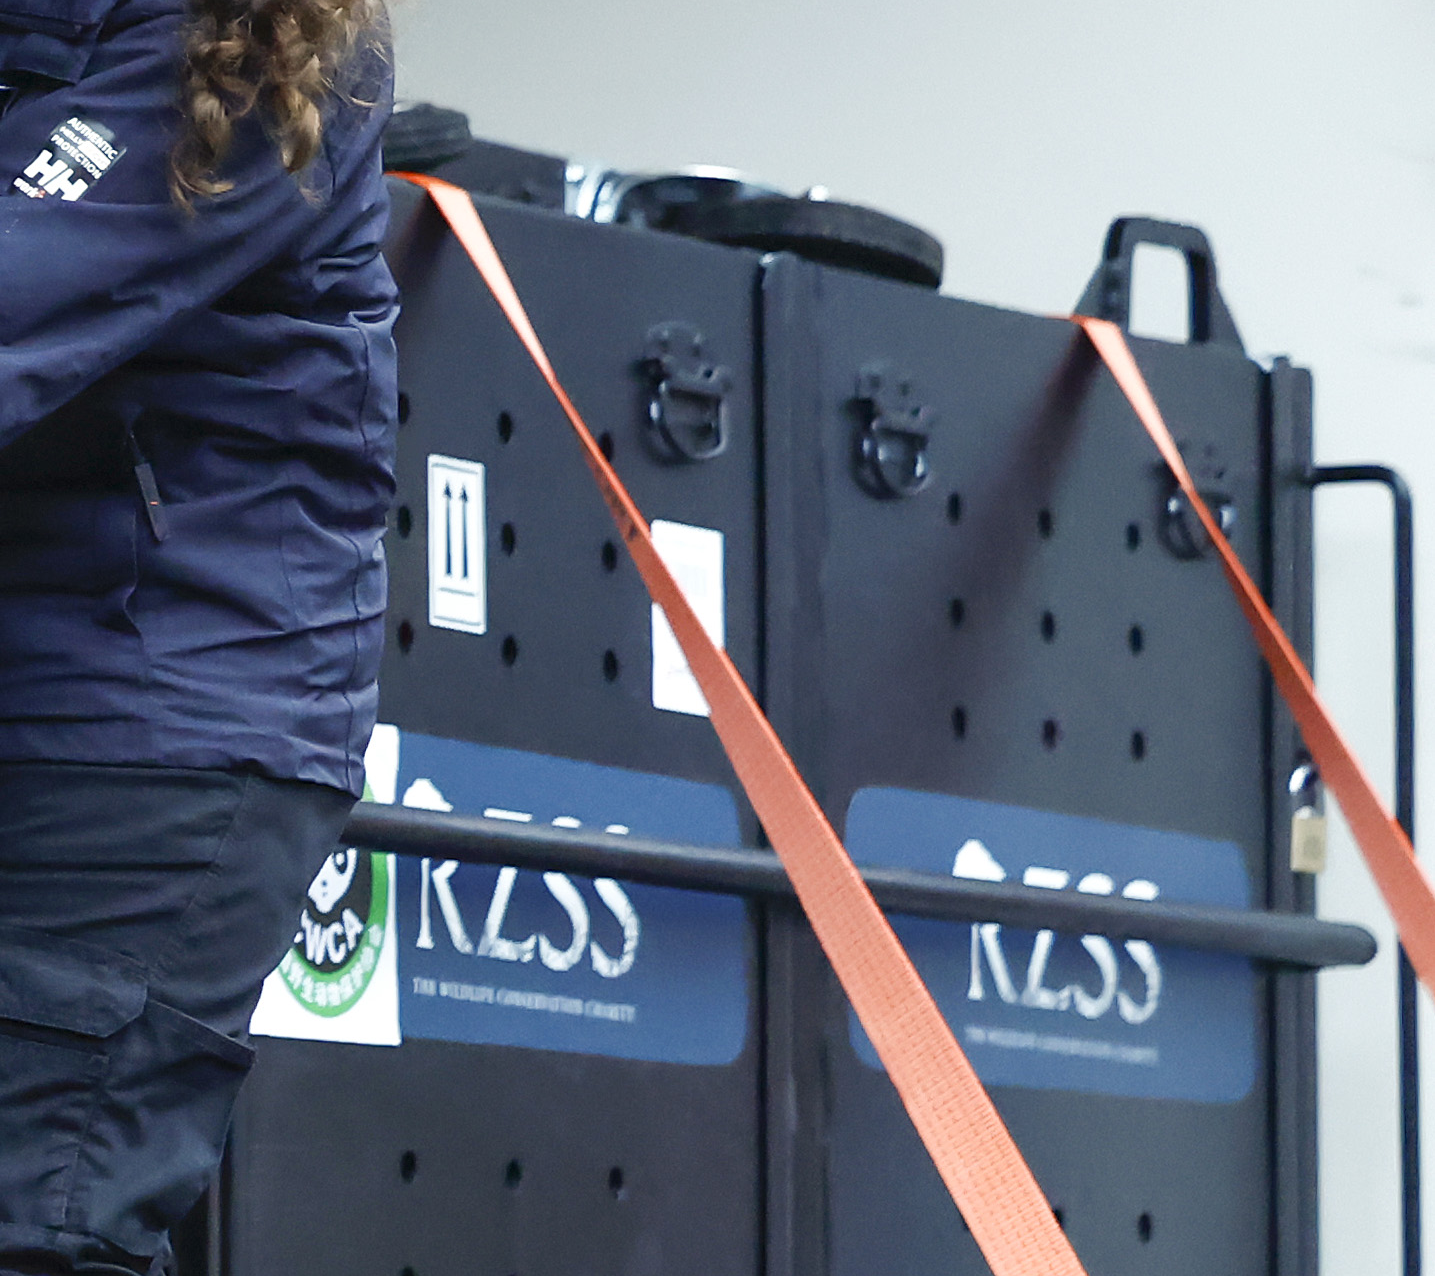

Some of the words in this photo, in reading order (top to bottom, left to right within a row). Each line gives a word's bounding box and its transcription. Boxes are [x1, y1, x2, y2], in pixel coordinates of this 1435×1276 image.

[51, 134, 104, 180] PROTECTION
[66, 117, 118, 160] AUTHENTIC
[402, 778, 642, 979] RZSS
